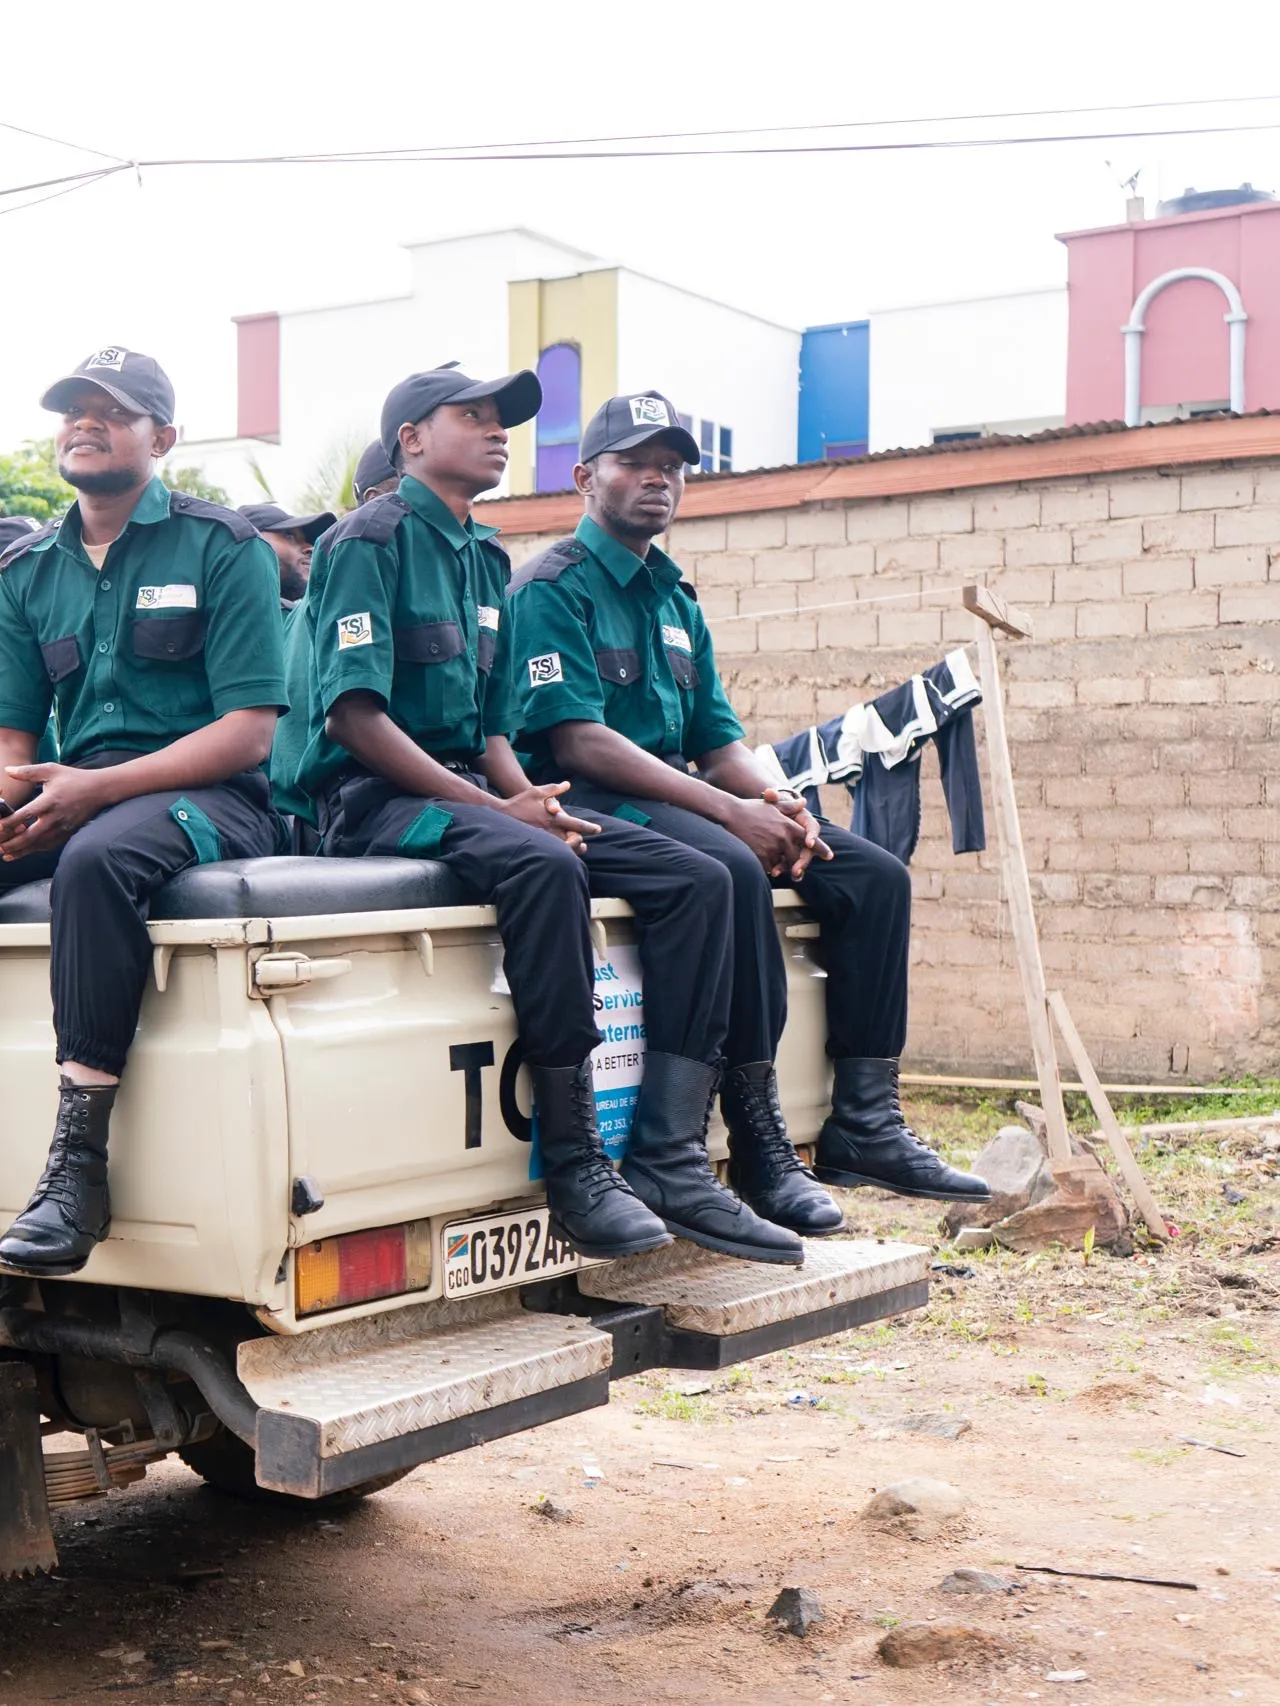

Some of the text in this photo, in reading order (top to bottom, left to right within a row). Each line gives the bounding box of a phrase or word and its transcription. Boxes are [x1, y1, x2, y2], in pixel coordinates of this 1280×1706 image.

[140, 588, 155, 601] TSI
[341, 616, 364, 637] TSI
[531, 656, 555, 674] TSI
[605, 1052, 640, 1071] BETTER
[619, 1097, 629, 1107] DE
[600, 1120, 613, 1133] 212
[448, 1267, 470, 1290] CGO
